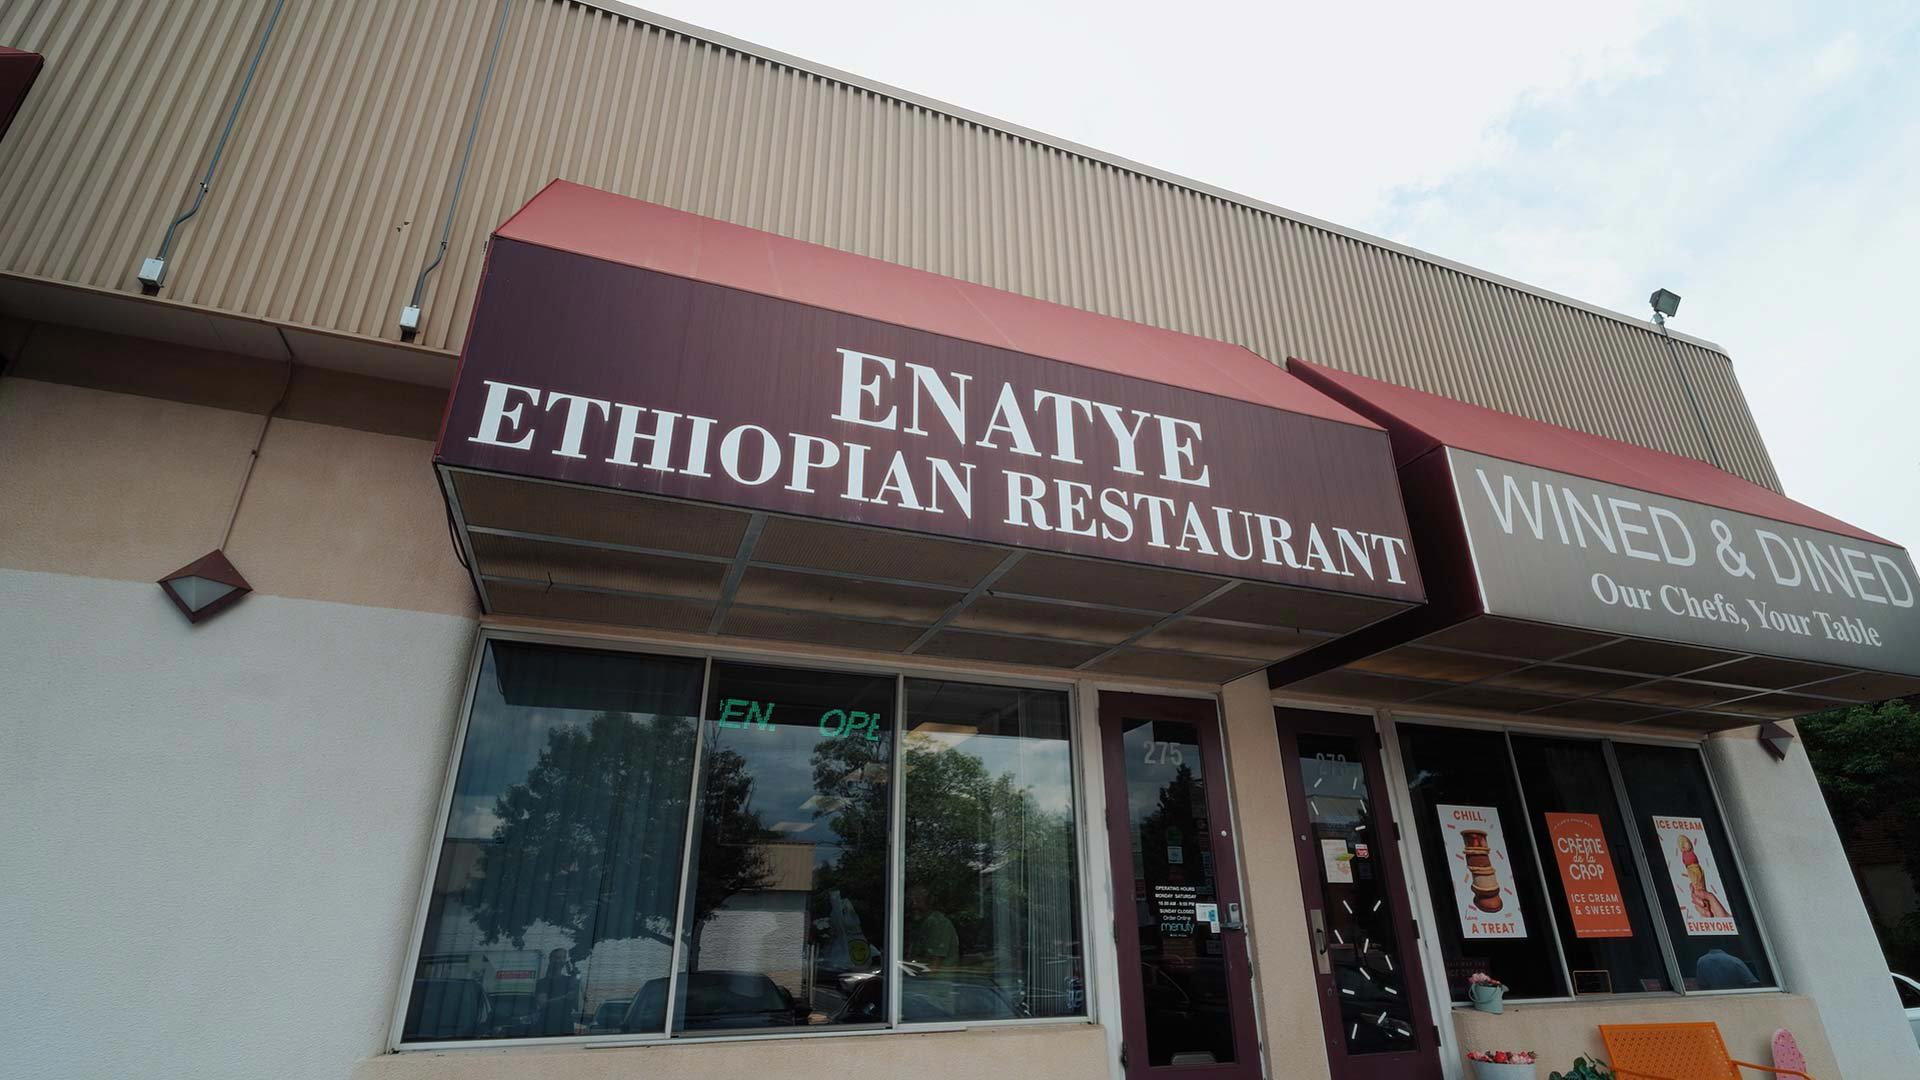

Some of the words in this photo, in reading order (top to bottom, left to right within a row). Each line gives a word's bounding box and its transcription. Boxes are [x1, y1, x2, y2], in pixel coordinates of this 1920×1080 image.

[831, 347, 1211, 488] ENATYE
[468, 380, 976, 519] ETHIOPIAN
[1002, 470, 1407, 585] RESTAURANT
[1475, 469, 1697, 566] WINED
[1710, 518, 1756, 580] &
[1755, 528, 1914, 608] DINED
[1590, 573, 1651, 610] Our
[1659, 584, 1750, 632] Chefs,
[1747, 598, 1811, 636] Your
[1812, 610, 1883, 647] Table
[1144, 741, 1183, 766] 275
[1453, 810, 1487, 823] CHILL,
[1655, 820, 1671, 830] ICE
[1672, 820, 1704, 831] CREAM
[1569, 864, 1604, 880] CROP
[1571, 893, 1586, 903] ICE
[1587, 893, 1619, 903] CREAM
[1575, 905, 1582, 915] &
[1584, 905, 1622, 915] SWEETS
[1471, 923, 1479, 934] A
[1481, 923, 1515, 934] TREAT
[1688, 921, 1735, 932] EVERYONE
